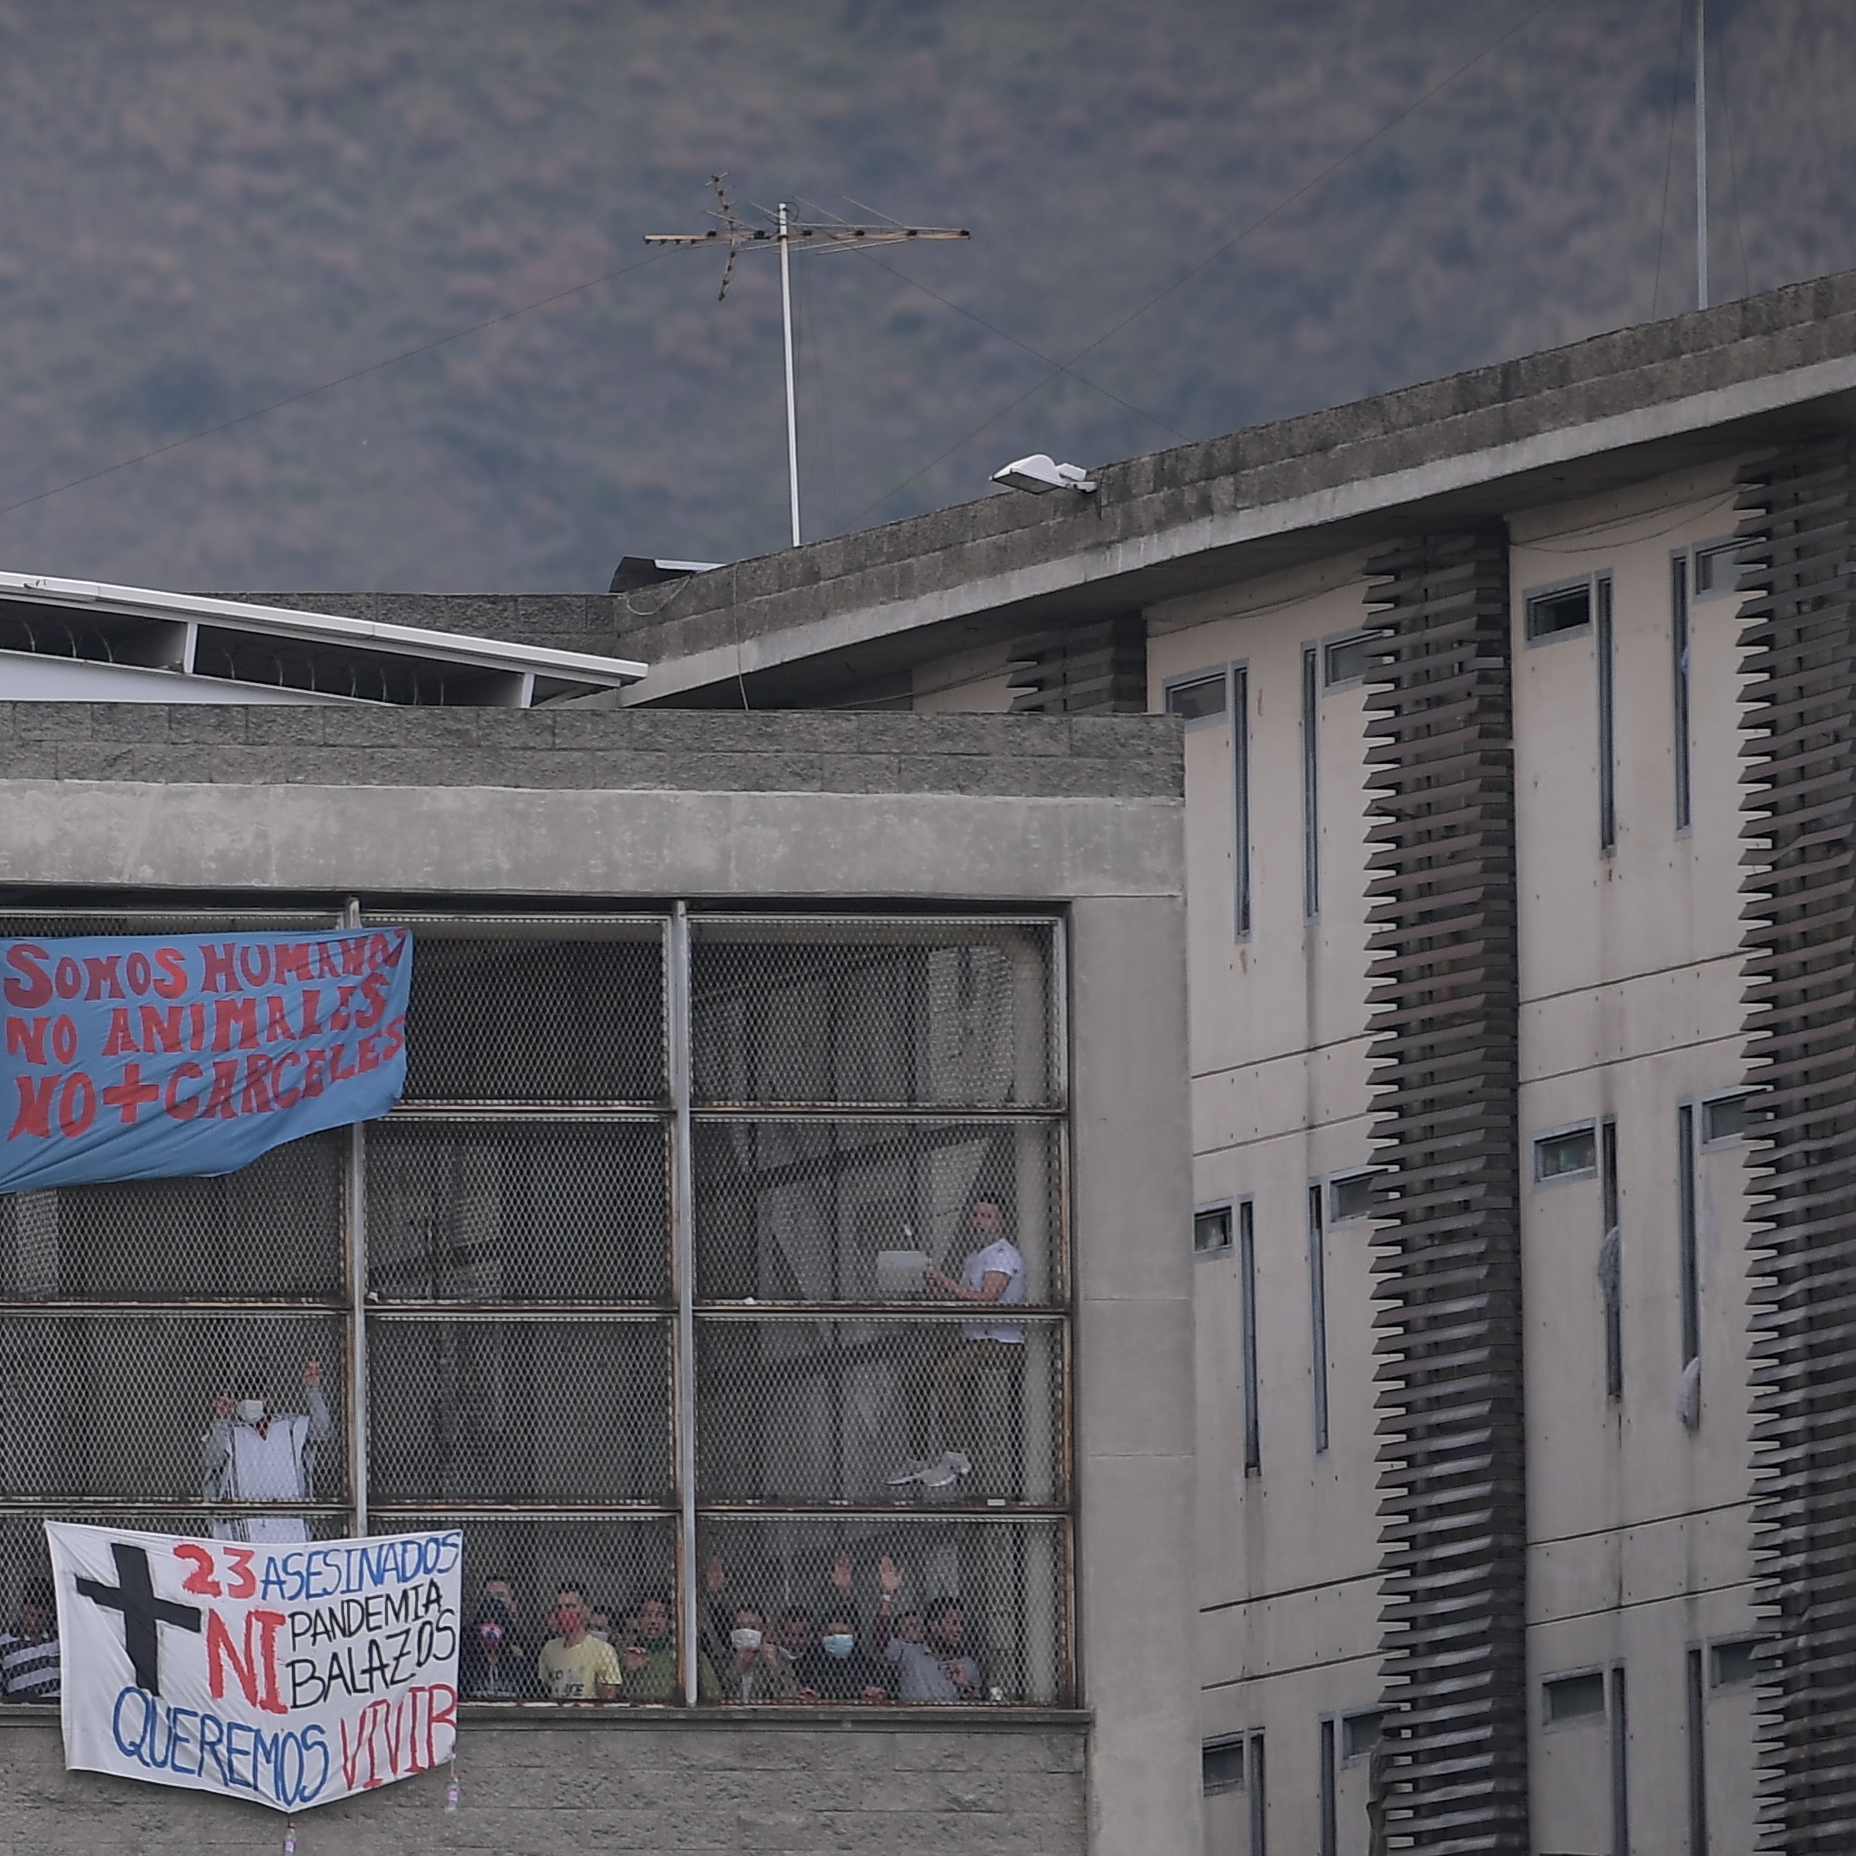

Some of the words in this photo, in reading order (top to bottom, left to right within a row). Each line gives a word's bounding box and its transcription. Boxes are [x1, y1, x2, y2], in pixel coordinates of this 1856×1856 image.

[3, 942, 188, 1009] SOMOS
[5, 1014, 77, 1065] NO
[102, 973, 390, 1056] ANIMALES
[173, 1543, 257, 1598] 23
[260, 1532, 461, 1600] ASESINADOS
[208, 1607, 289, 1714] NI
[288, 1579, 442, 1652] PANDEMIA
[286, 1609, 456, 1709] BALAZOS
[112, 1686, 330, 1807] QUEREMOS
[340, 1683, 458, 1792] VIVIR
